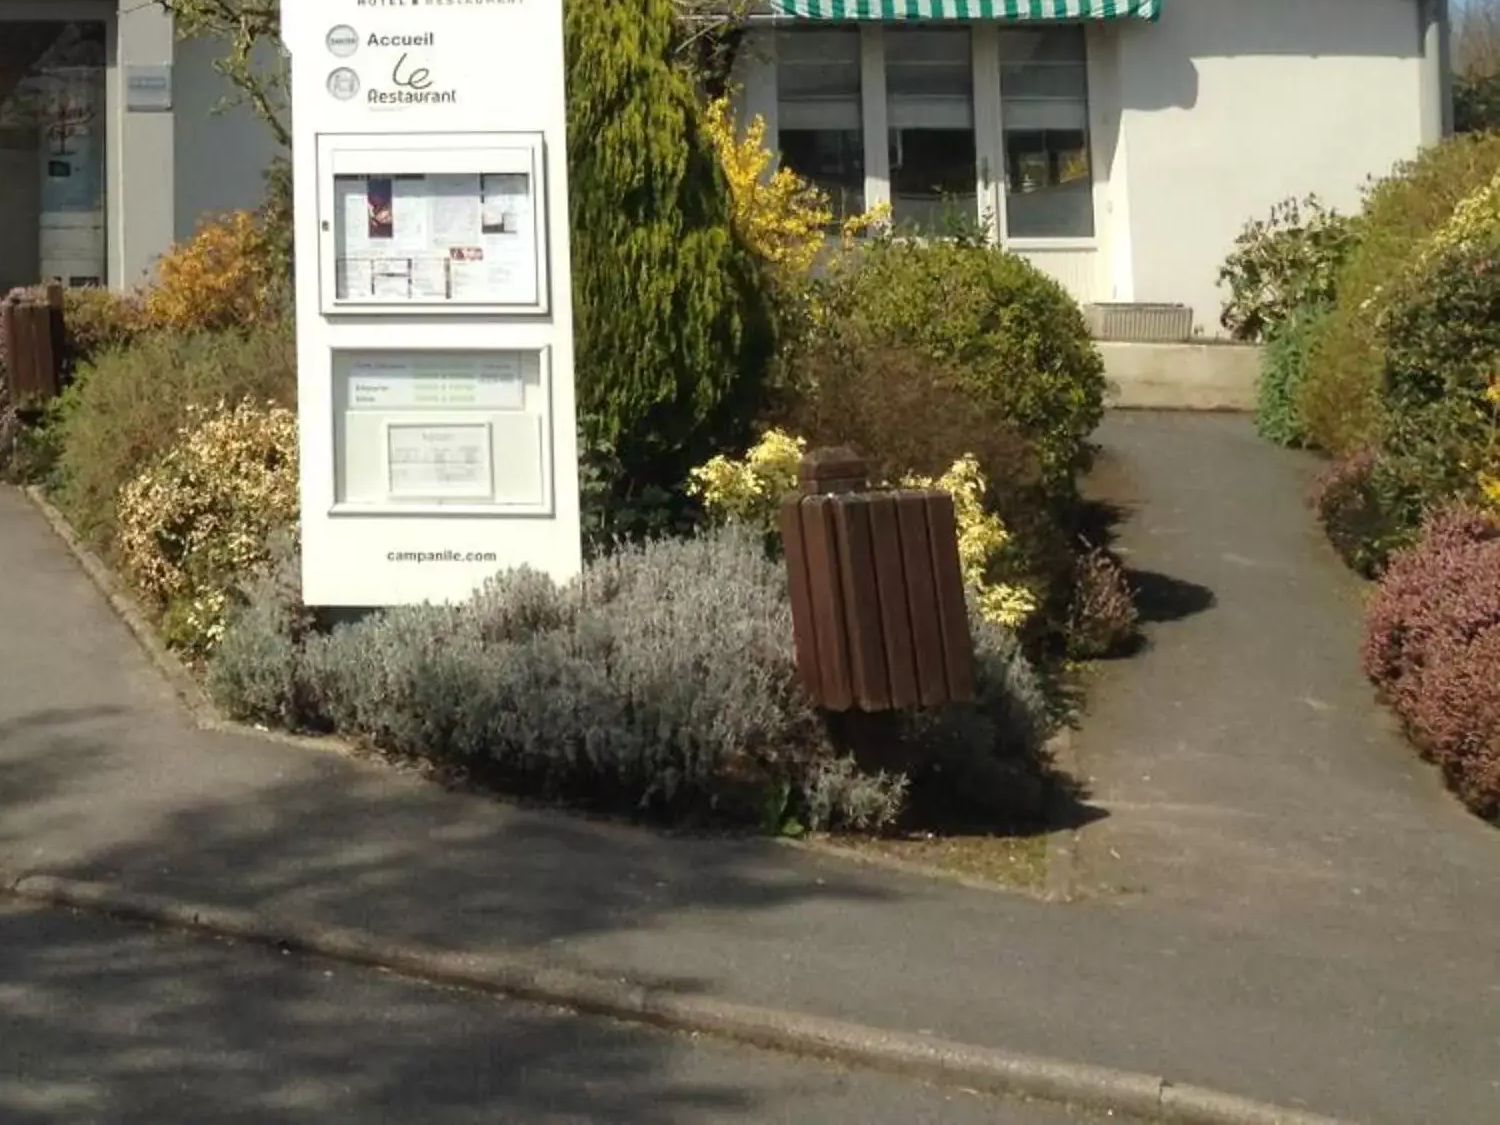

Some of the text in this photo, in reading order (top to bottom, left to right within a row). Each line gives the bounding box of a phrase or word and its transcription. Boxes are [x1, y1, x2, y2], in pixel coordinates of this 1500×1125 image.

[367, 31, 435, 47] Accueil
[392, 52, 434, 90] Le
[367, 88, 457, 104] Restaurant
[387, 549, 497, 564] campanile.com
